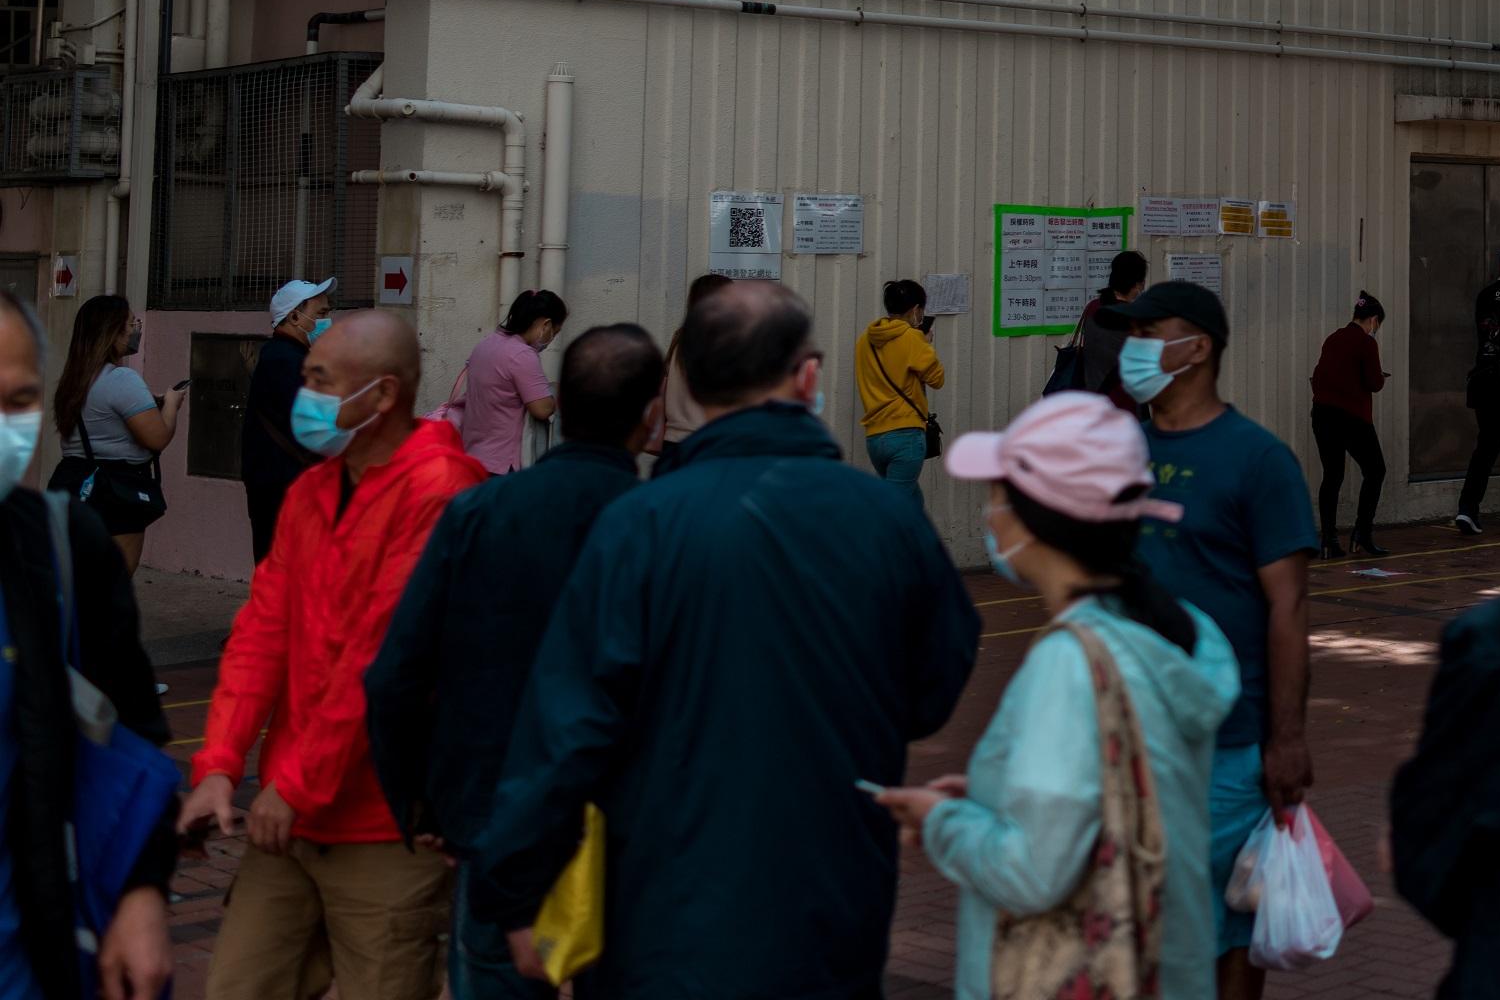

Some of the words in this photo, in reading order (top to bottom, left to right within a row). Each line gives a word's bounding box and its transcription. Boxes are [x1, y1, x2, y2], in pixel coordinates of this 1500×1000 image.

[1008, 259, 1038, 269] 上午時段
[1008, 298, 1037, 307] 下午時段
